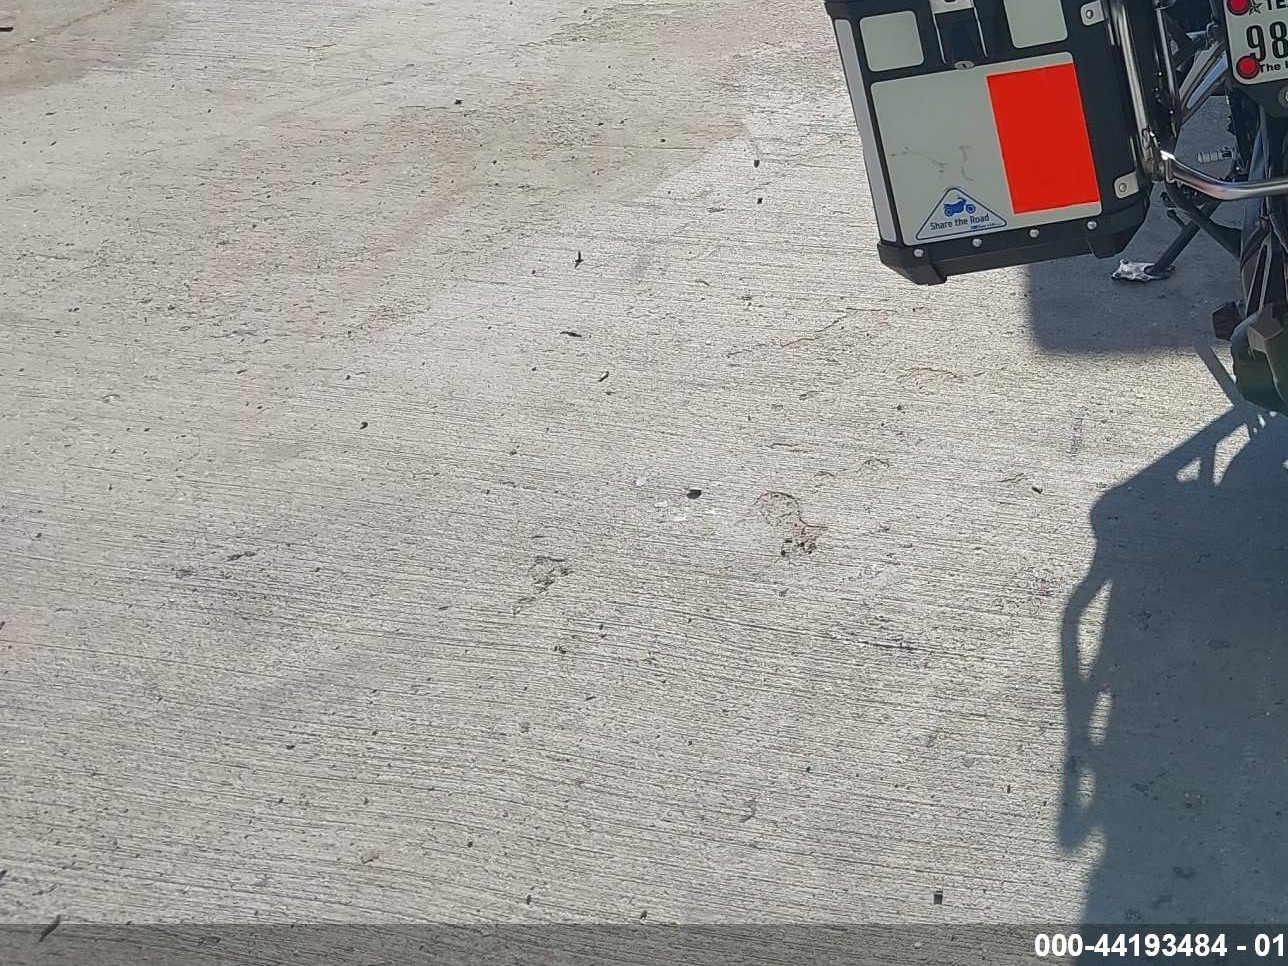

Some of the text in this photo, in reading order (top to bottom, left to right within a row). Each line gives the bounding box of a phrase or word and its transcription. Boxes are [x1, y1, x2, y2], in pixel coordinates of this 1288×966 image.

[1260, 63, 1281, 73] The
[930, 221, 953, 230] Share
[955, 218, 968, 226] the
[969, 213, 990, 224] Road
